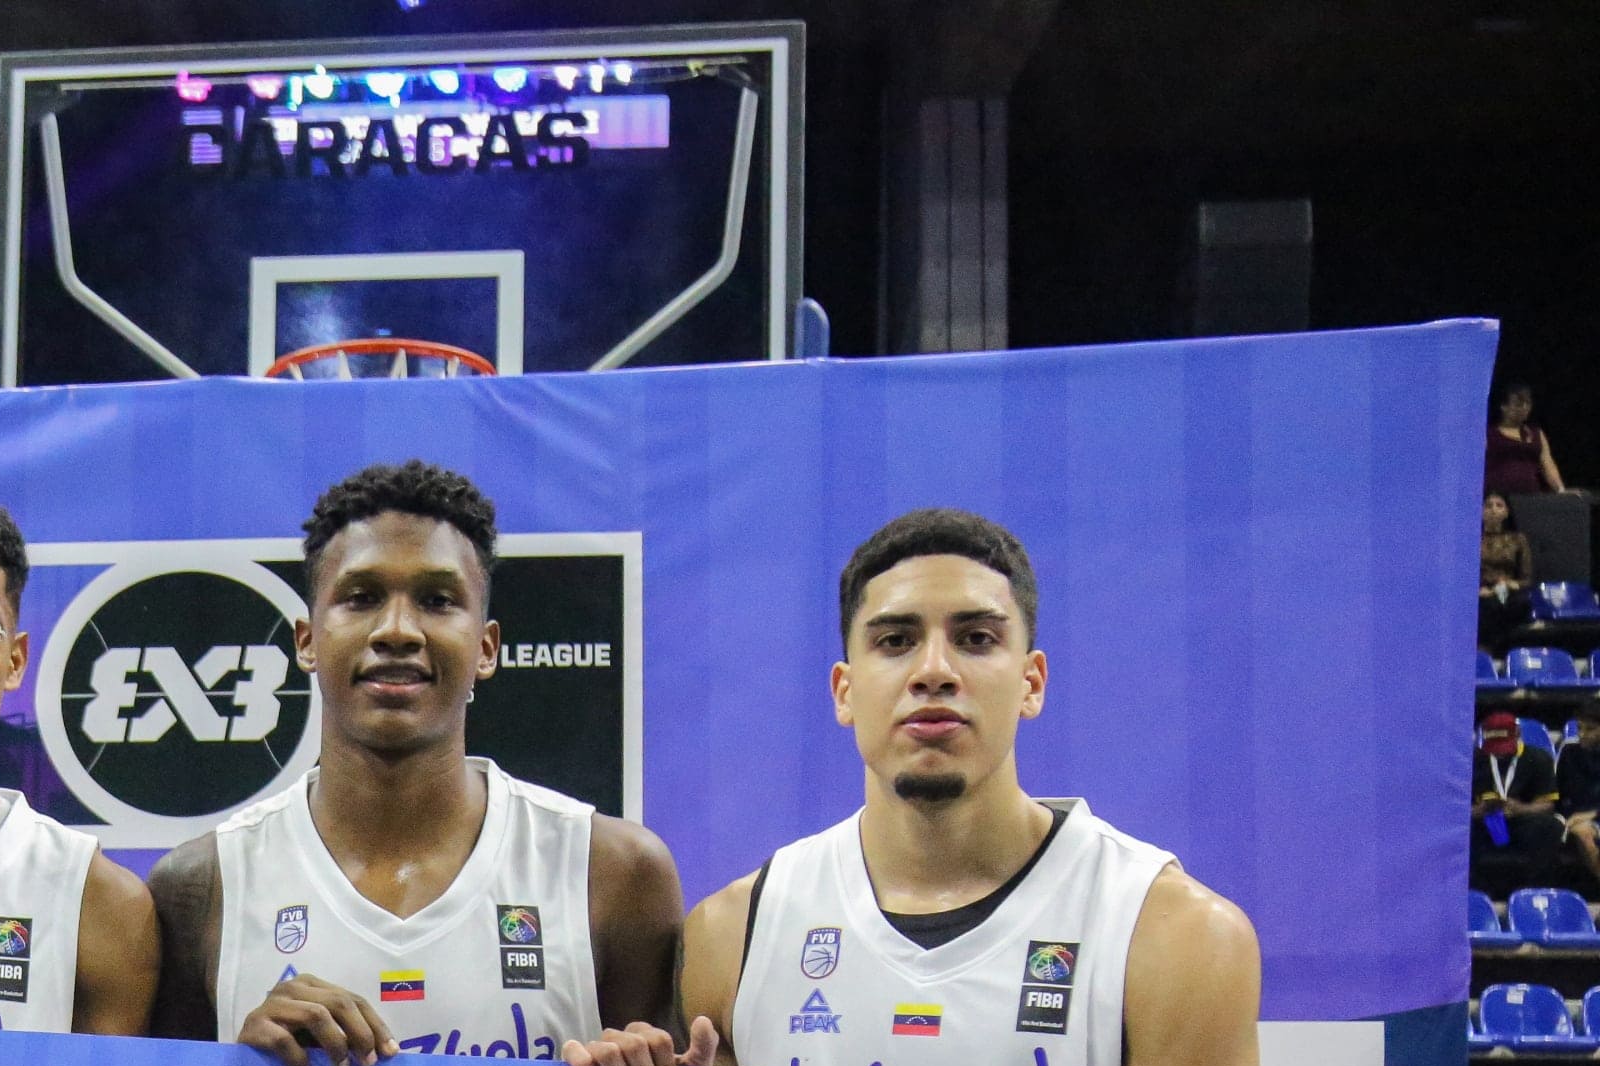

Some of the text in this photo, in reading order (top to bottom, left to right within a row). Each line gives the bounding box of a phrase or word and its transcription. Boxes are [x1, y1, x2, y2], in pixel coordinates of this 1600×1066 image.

[179, 112, 590, 176] CARACAS
[500, 642, 611, 668] LEAGUE
[281, 911, 303, 923] FVB
[811, 933, 836, 944] FVB
[507, 952, 538, 967] FIBA
[1026, 991, 1064, 1009] FIBA
[789, 1014, 843, 1034] PEAK
